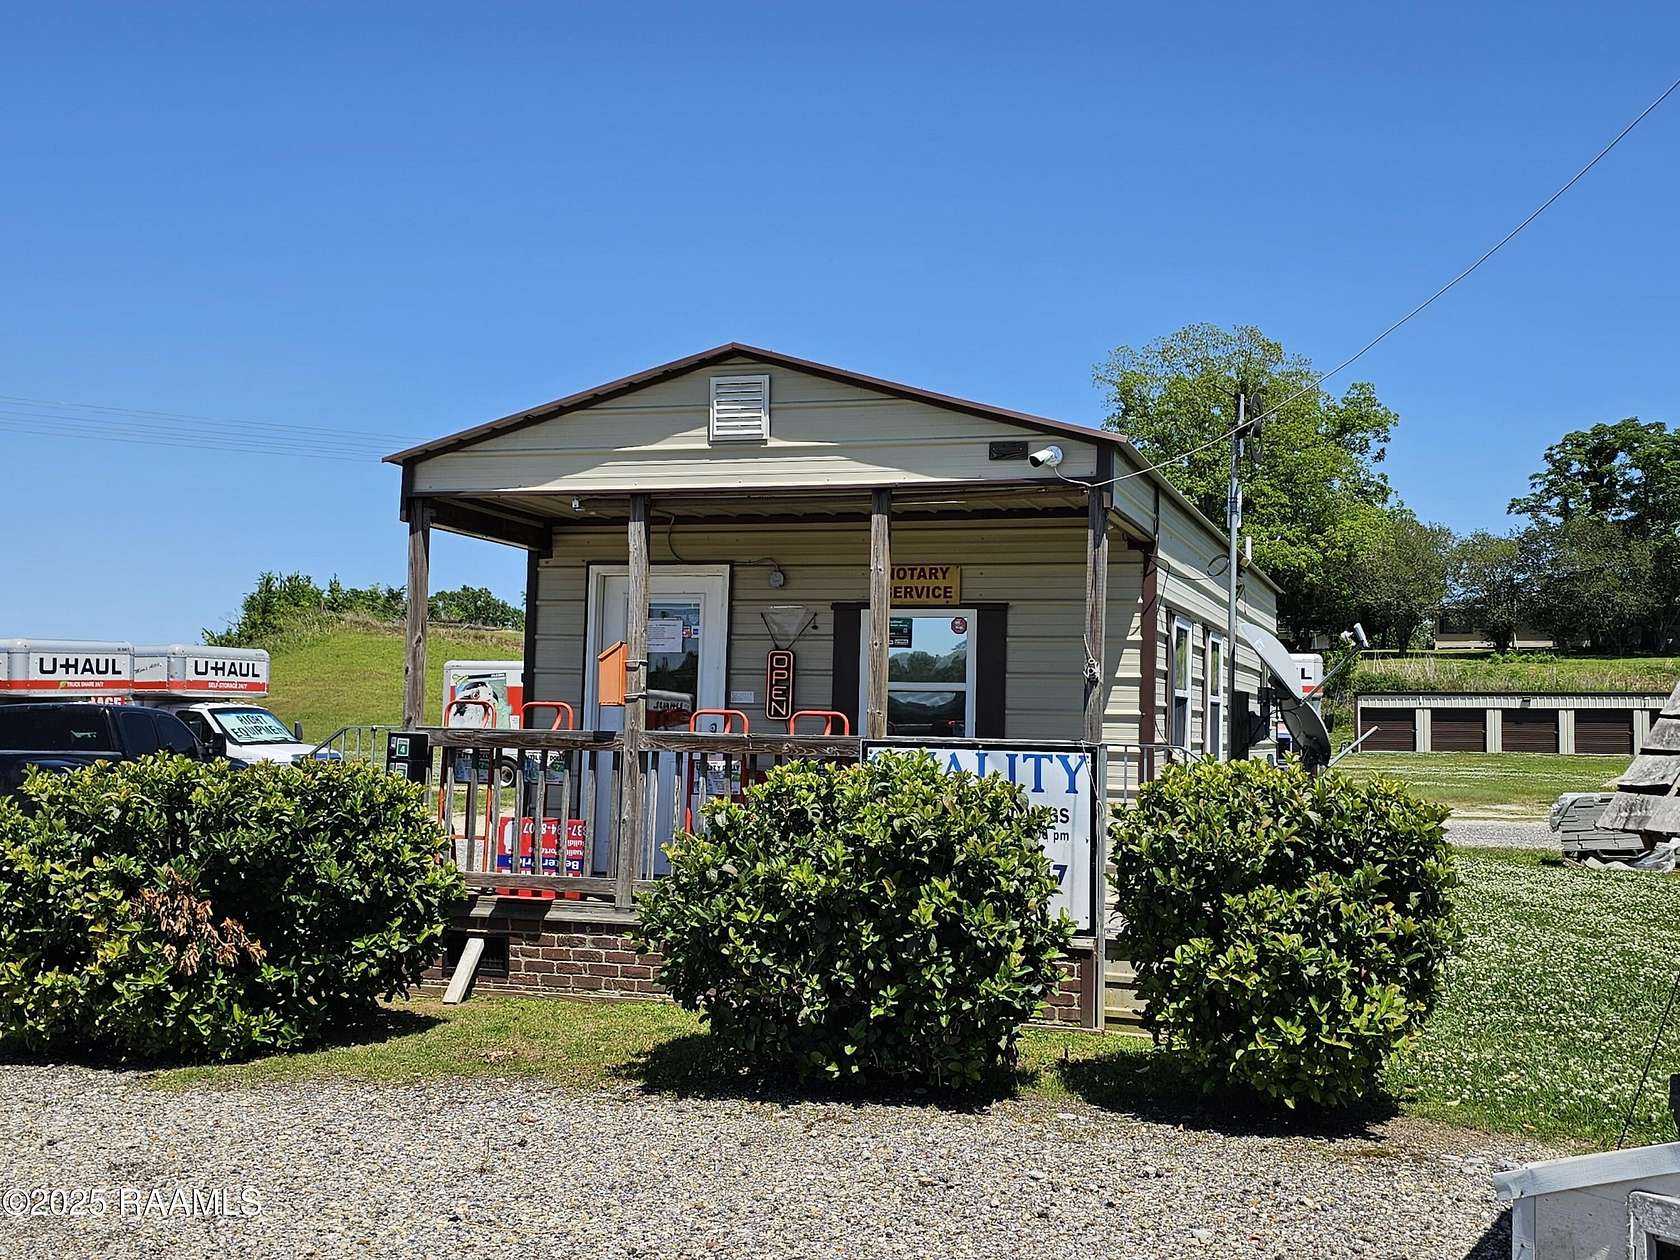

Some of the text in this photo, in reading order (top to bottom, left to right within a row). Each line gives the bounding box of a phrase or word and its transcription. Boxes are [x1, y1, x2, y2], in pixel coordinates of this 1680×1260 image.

[39, 657, 122, 675] U-HAUL
[194, 660, 260, 678] U-HAUL
[771, 655, 788, 716] OPEN
[236, 714, 268, 725] RIGHT
[872, 751, 1089, 794] ALITY
[1053, 831, 1069, 843] pm
